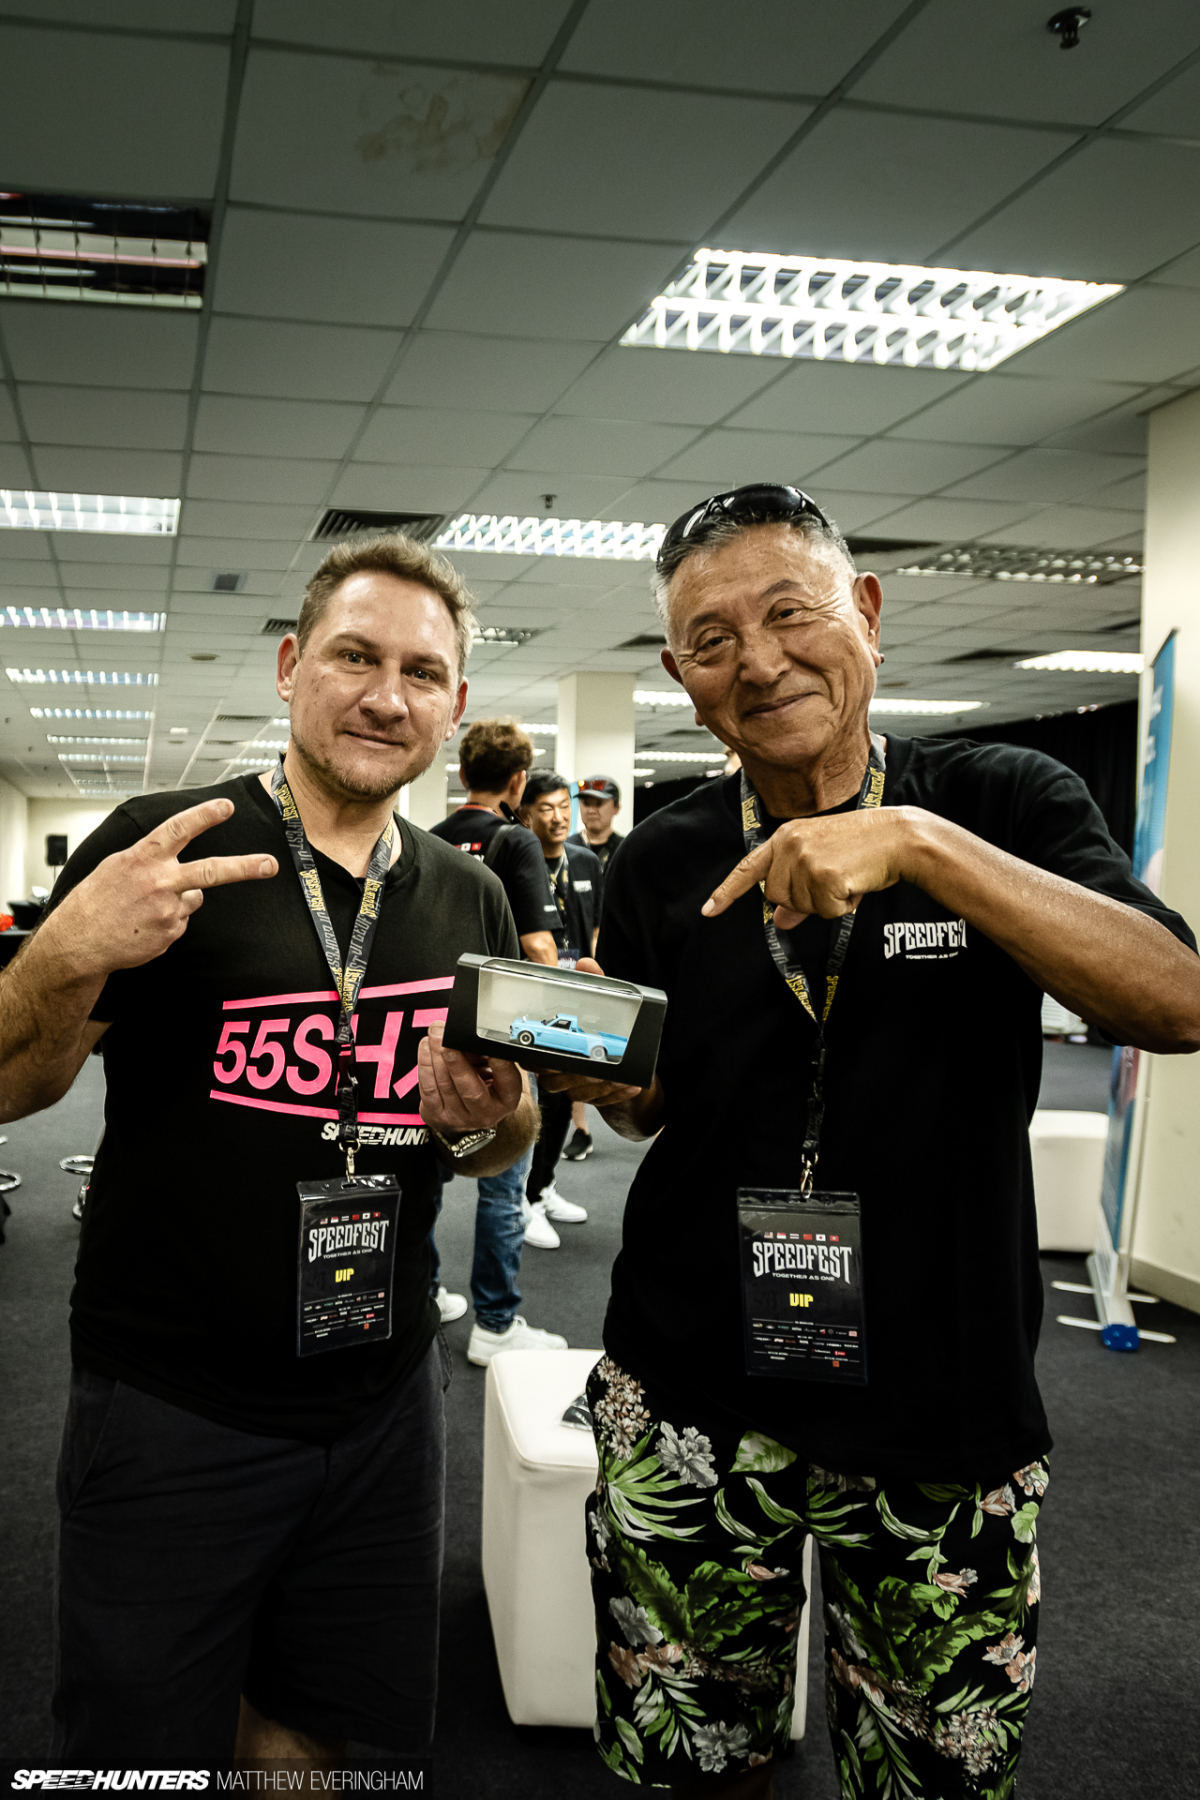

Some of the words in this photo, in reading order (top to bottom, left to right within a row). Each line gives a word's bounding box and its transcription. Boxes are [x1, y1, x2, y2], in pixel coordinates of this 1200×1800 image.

[308, 1220, 390, 1263] SPEEDFEST
[752, 1241, 852, 1285] SPEEDFEST
[772, 1272, 808, 1280] TOGETHER
